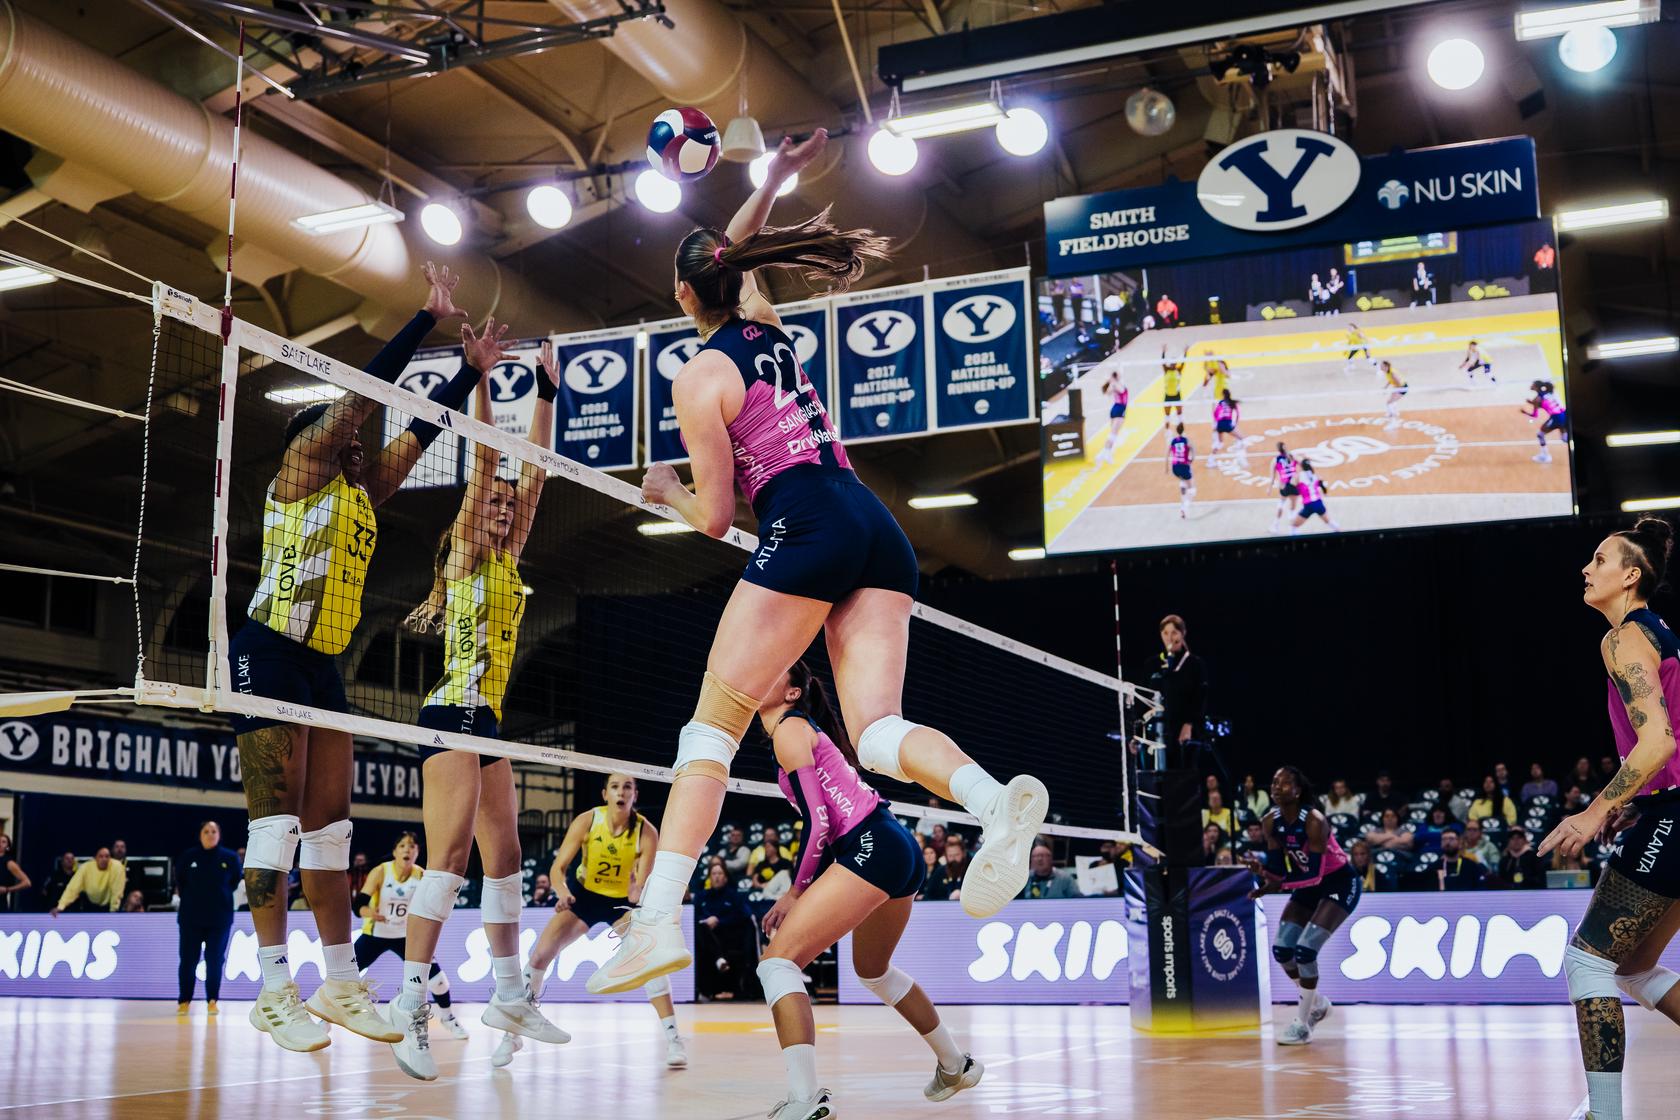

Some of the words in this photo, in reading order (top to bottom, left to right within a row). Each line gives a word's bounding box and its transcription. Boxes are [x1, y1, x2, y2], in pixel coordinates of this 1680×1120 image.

[1414, 175, 1456, 204] NU
[1460, 166, 1522, 198] SKIN
[1089, 206, 1156, 230] SMITH
[1058, 224, 1190, 257] FIELDHOUSE
[280, 344, 307, 364] SALT
[306, 353, 332, 376] LAKE
[867, 365, 896, 380] 2017
[951, 363, 1011, 381] NATIONAL
[964, 351, 996, 367] 2021
[754, 342, 814, 410] 22
[854, 377, 911, 395] NATIONAL
[947, 376, 1016, 396] RUNNER-UP
[850, 389, 916, 409] RUNNER-UP
[564, 425, 625, 442] RUNNER-UP
[568, 413, 621, 429] NATIONAL
[348, 519, 376, 562] 33
[513, 591, 523, 621] 7
[52, 724, 199, 779] BRIGHAM
[815, 767, 855, 818] ATLANTA
[597, 862, 621, 877] 21
[388, 903, 408, 917] 16
[1161, 915, 1175, 953] sports
[0, 930, 120, 981] KIMS
[1162, 953, 1177, 999] imports
